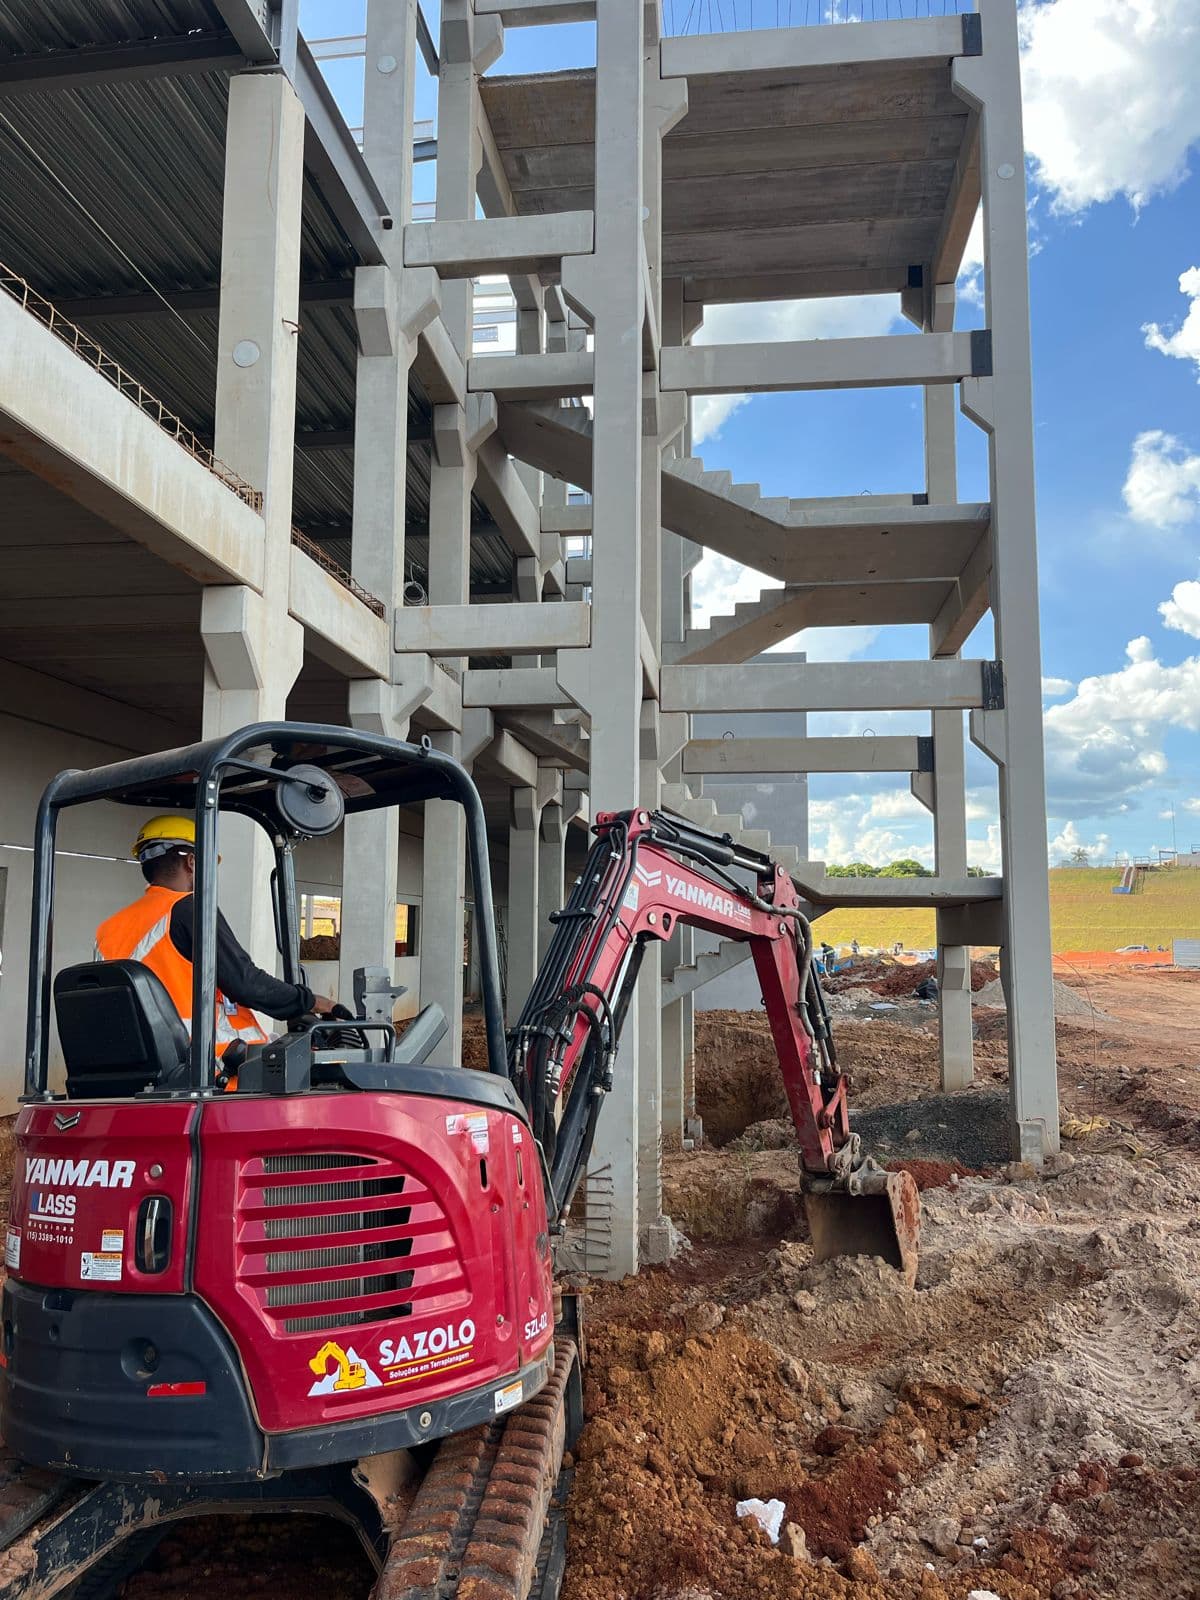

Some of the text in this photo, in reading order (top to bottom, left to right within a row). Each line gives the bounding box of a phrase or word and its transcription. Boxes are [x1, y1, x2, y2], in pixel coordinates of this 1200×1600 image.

[665, 874, 734, 918] YANMAR
[25, 1158, 136, 1188] YANMAR
[38, 1192, 77, 1216] LASS
[26, 1231, 74, 1245] (15) 3389-1010
[524, 1311, 548, 1340] SZL-02
[379, 1319, 476, 1366] SAZOLO
[389, 1352, 470, 1379] Soluções em Terraplanagem
